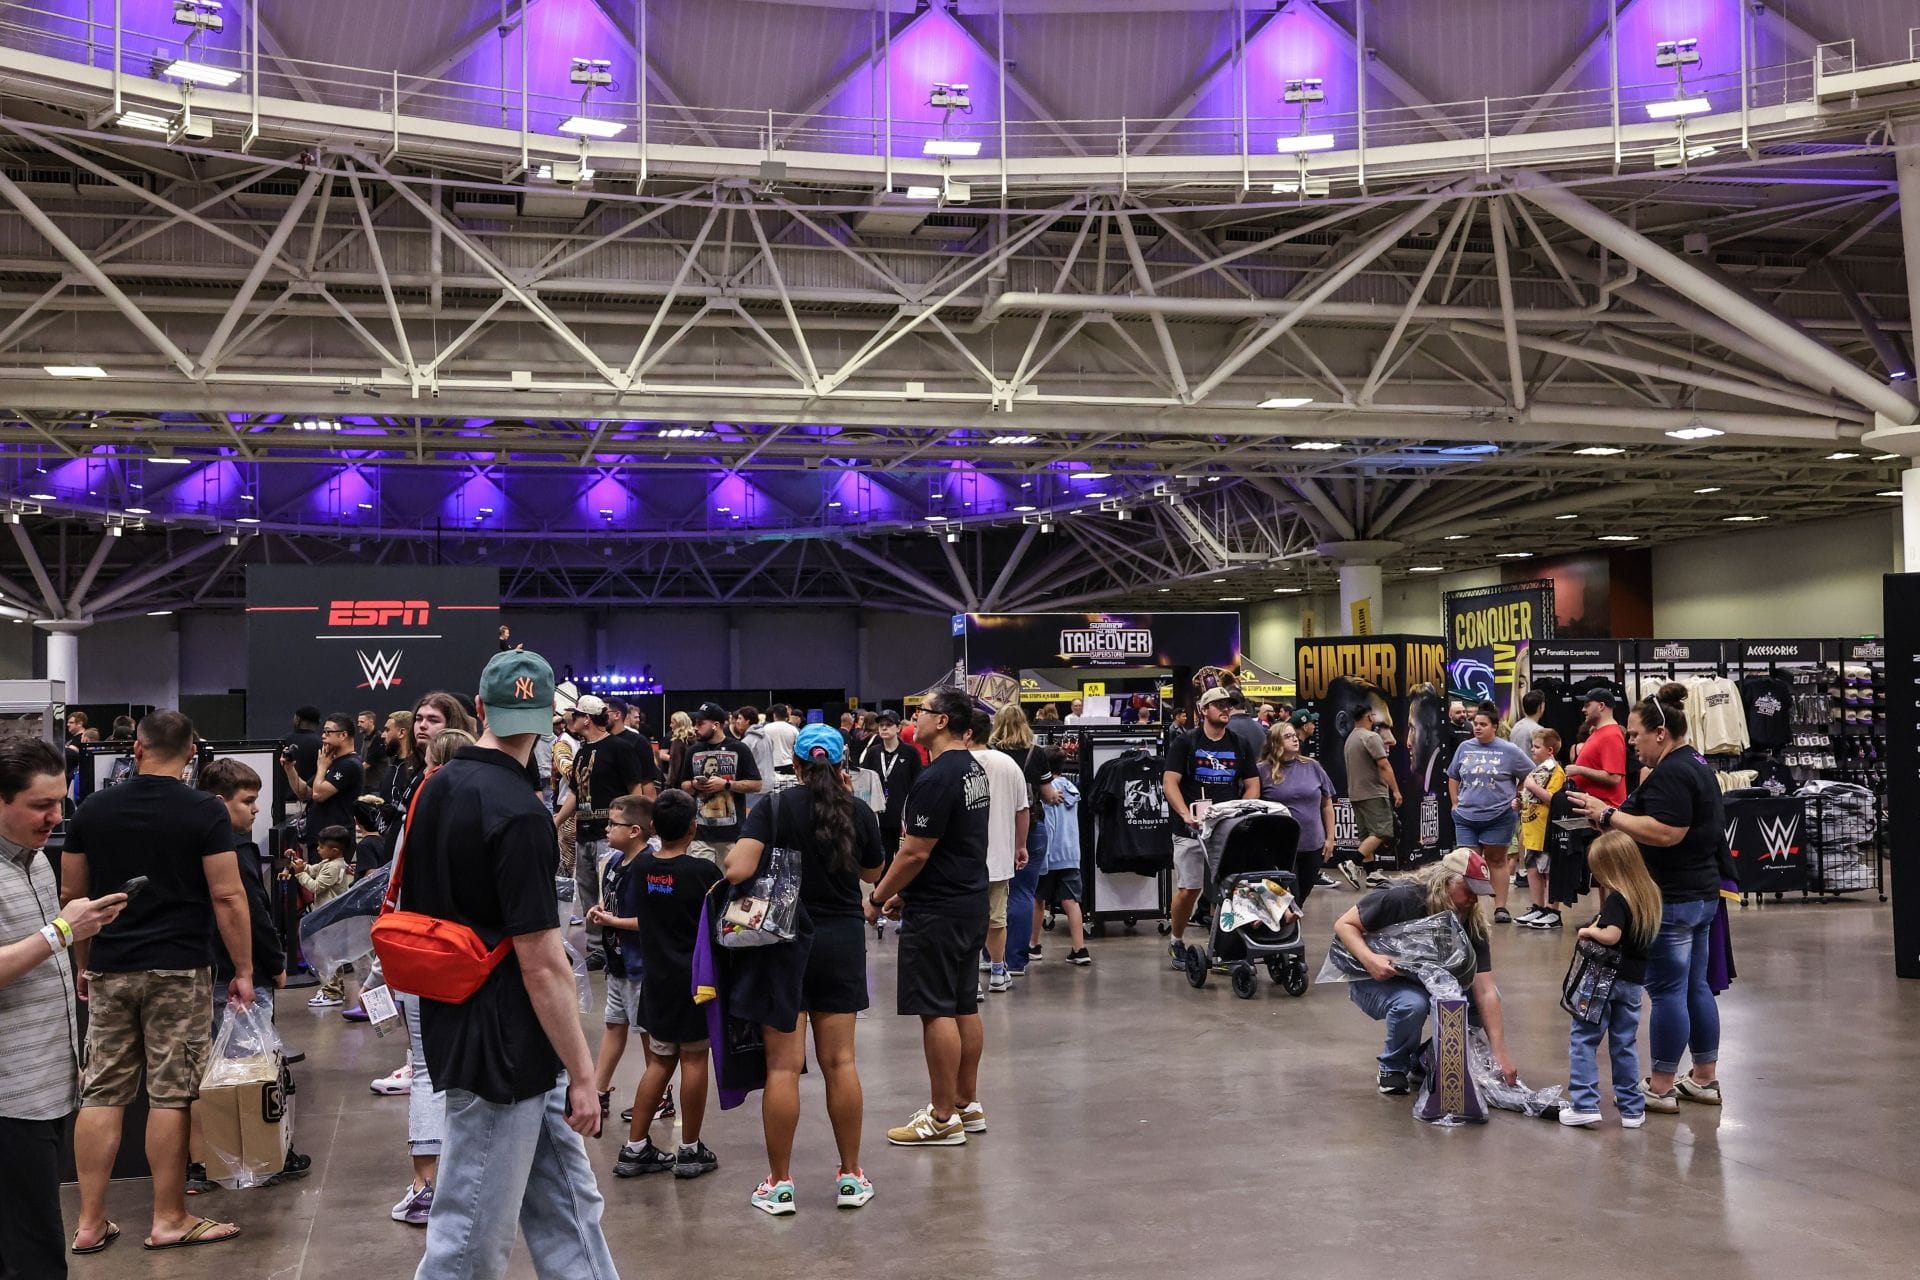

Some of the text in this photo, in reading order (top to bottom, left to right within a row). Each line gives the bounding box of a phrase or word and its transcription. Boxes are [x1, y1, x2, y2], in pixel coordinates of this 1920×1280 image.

[328, 600, 430, 626] ESPN
[1455, 601, 1533, 650] CONQUER
[1064, 632, 1148, 652] TAKEOVER
[1747, 645, 1798, 656] ACCESSORIES
[1570, 649, 1600, 657] Experience
[1656, 648, 1688, 657] TAKEOVER
[1298, 643, 1398, 699] GUNTHER
[1494, 642, 1516, 684] LIV
[515, 676, 535, 700] NY
[1422, 804, 1437, 822] TAKE
[1422, 820, 1437, 838] OVER
[915, 1124, 935, 1139] N
